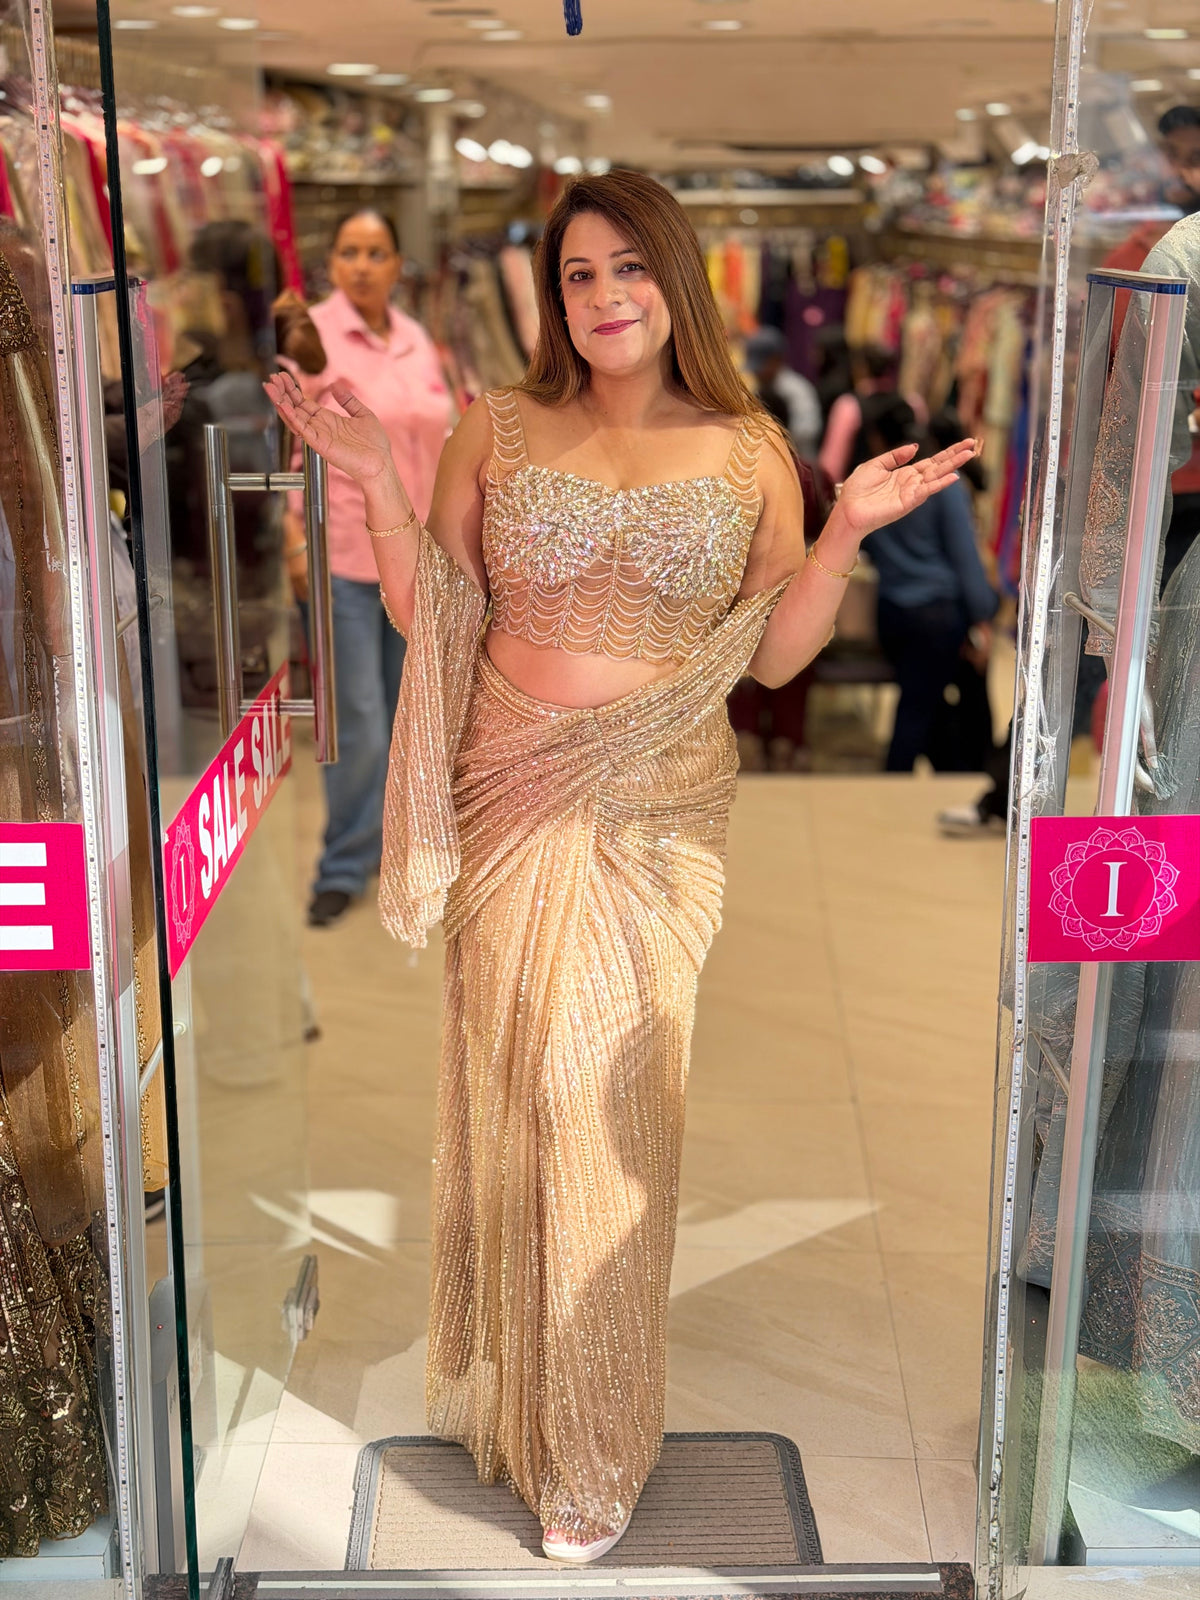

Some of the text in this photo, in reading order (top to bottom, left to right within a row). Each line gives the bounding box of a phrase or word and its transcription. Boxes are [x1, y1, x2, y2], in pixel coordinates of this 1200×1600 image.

[199, 675, 290, 899] SALE SALE
[1100, 861, 1127, 917] I
